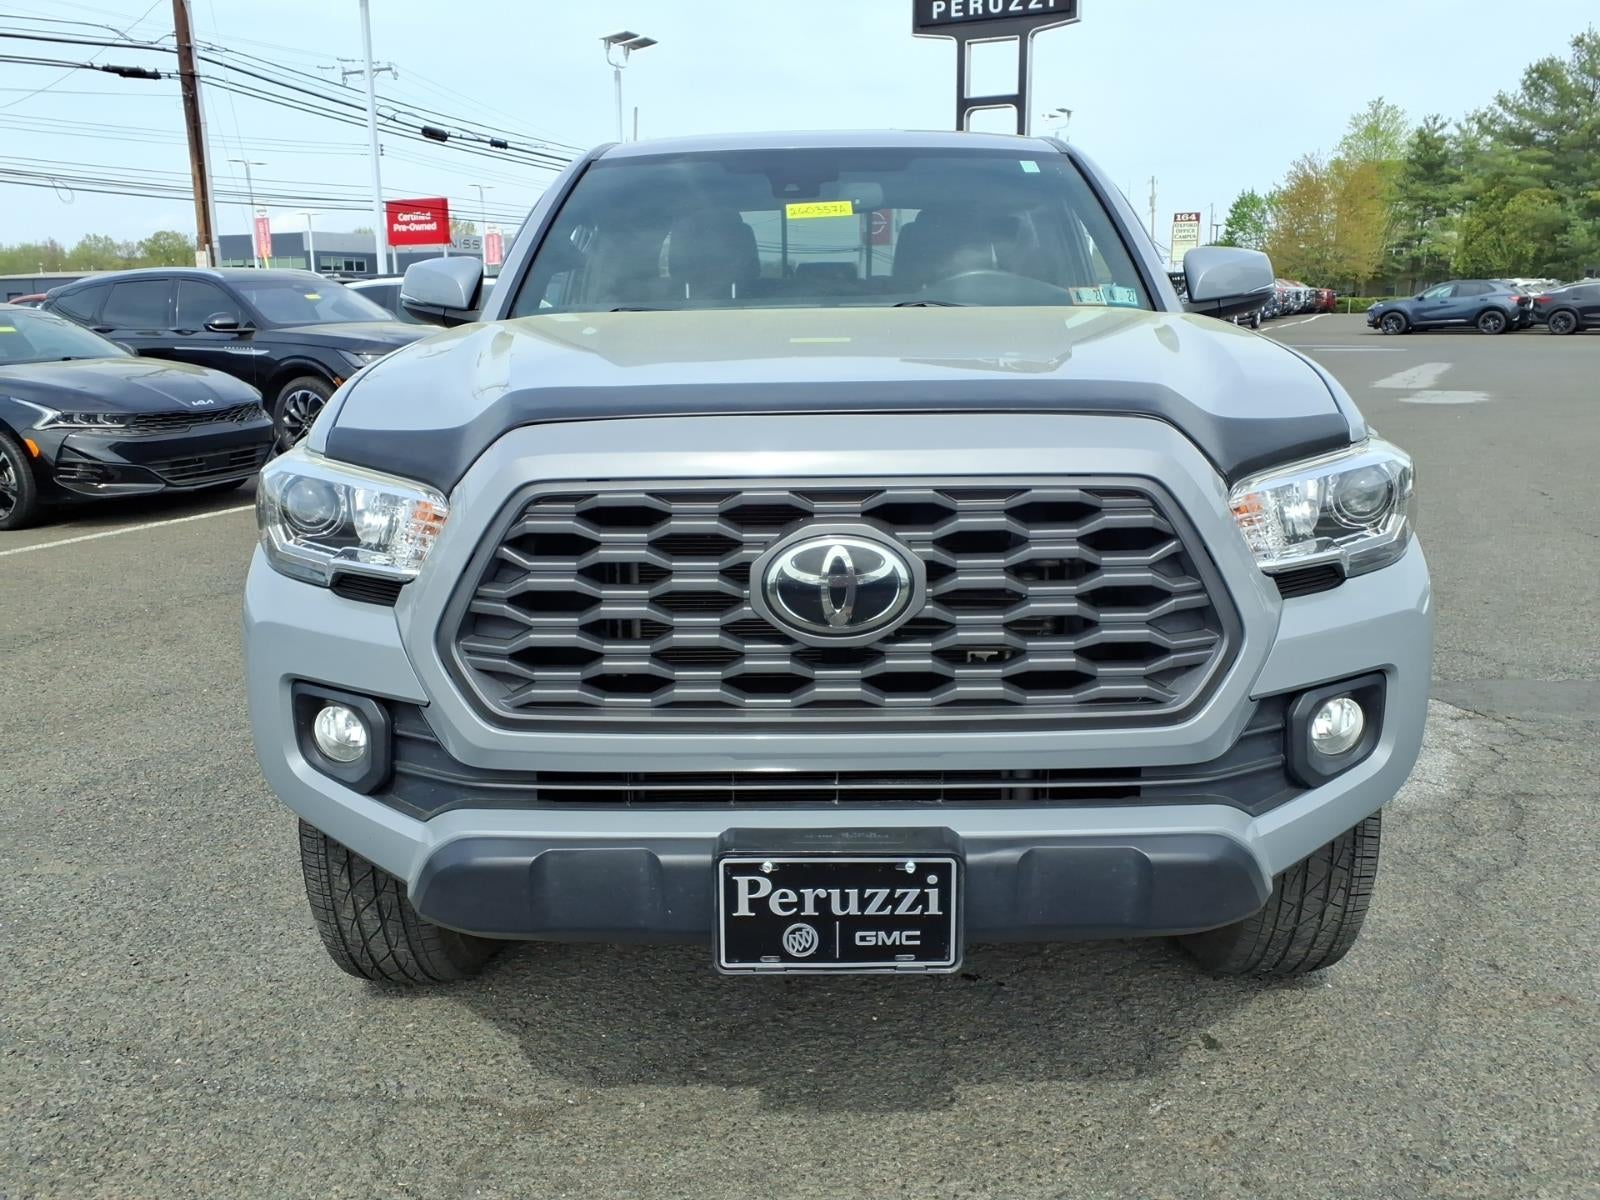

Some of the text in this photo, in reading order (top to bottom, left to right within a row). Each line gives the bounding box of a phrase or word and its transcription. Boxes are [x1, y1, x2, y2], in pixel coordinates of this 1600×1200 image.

[397, 211, 431, 222] Certified
[393, 221, 437, 232] Pre-Owned
[448, 238, 481, 251] NISS
[732, 874, 943, 916] Peruzzi
[855, 931, 921, 946] GMC
